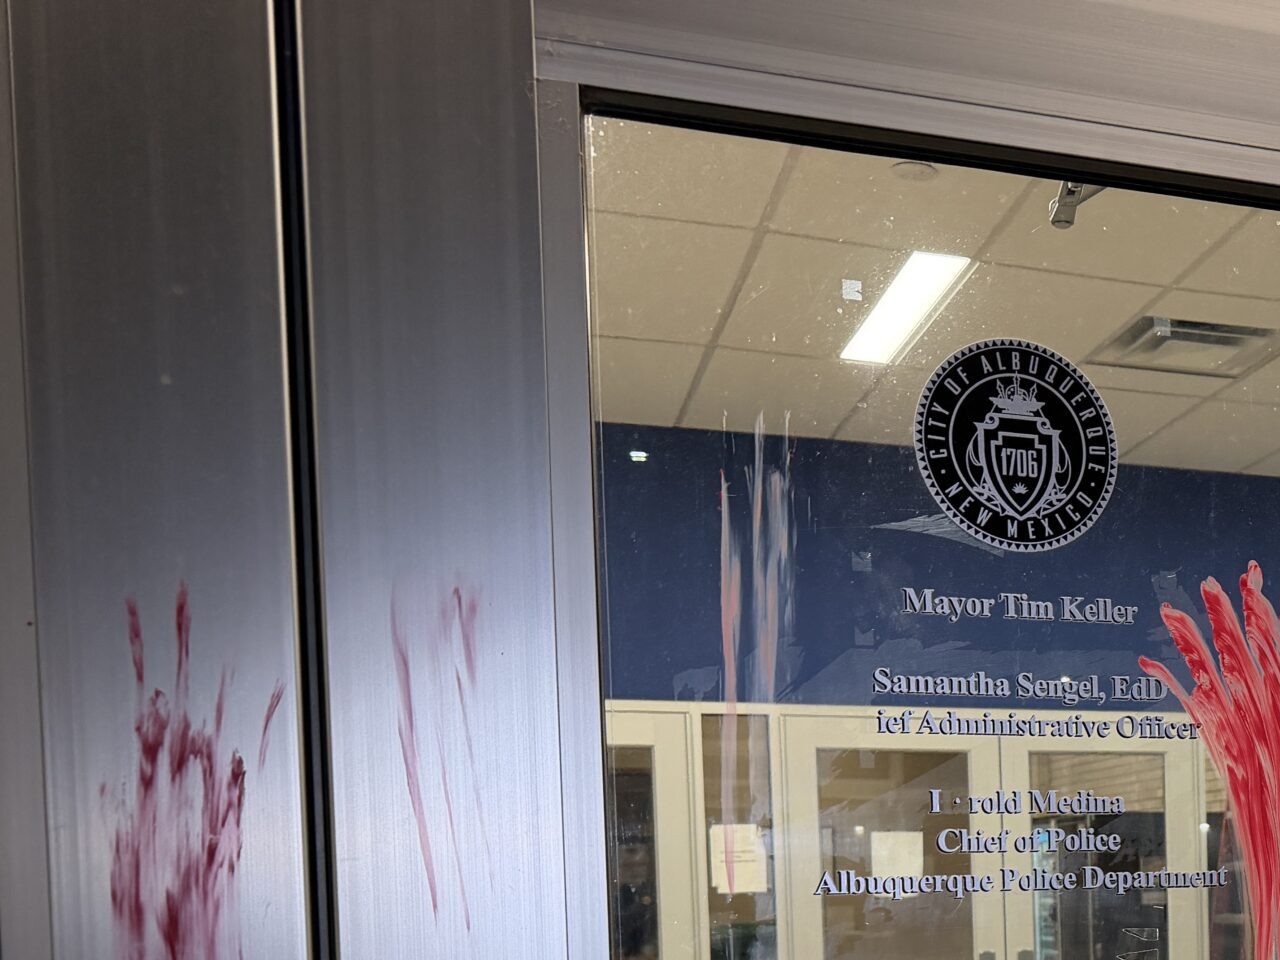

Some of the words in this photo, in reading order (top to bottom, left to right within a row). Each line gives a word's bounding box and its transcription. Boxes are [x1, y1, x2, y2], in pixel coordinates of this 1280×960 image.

[927, 402, 950, 459] CITY
[944, 366, 970, 396] OF
[980, 351, 1107, 474] ALBUQUERQUE
[1000, 447, 1039, 478] 1706
[944, 480, 993, 527] NEW
[1006, 491, 1094, 540] MEXICO
[902, 586, 995, 622] Mayor
[998, 593, 1055, 621] Tim
[1060, 596, 1138, 625] Keller
[872, 667, 1011, 698] Samantha
[1015, 672, 1106, 706] Sengel,
[1110, 675, 1168, 701] EdD
[916, 710, 1110, 738] Administrative
[1116, 715, 1202, 740] Officer
[1028, 789, 1126, 815] Medina
[936, 828, 1010, 854] Chief
[1013, 828, 1045, 853] of
[1046, 828, 1122, 853] Police
[813, 869, 994, 900] Albuquerque
[1000, 868, 1076, 893] Police
[1081, 866, 1229, 895] Department
